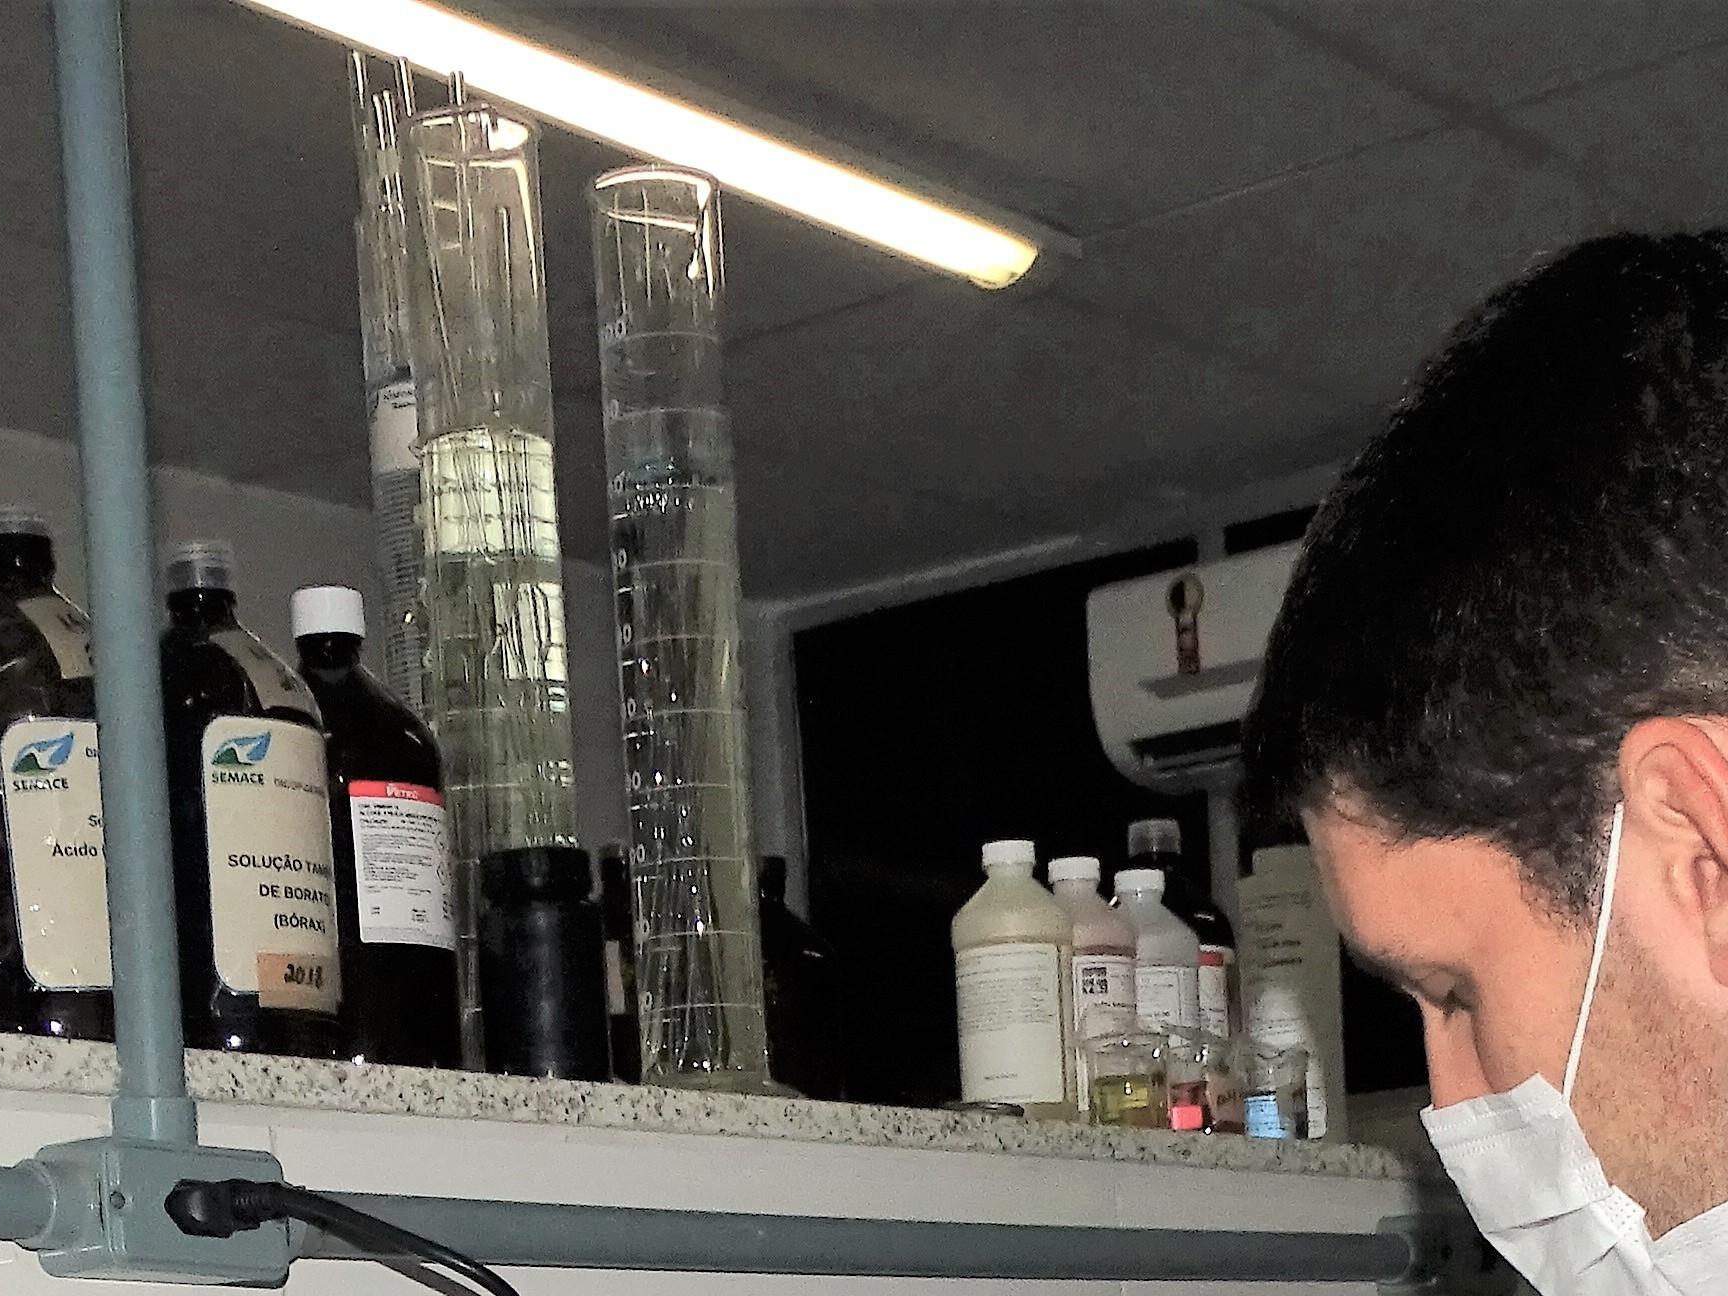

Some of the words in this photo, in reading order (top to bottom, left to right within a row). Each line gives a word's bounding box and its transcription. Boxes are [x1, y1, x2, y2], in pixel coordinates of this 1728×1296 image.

[211, 771, 265, 786] SEMACE
[228, 853, 303, 873] SOLUÇÃO
[259, 883, 280, 899] DE
